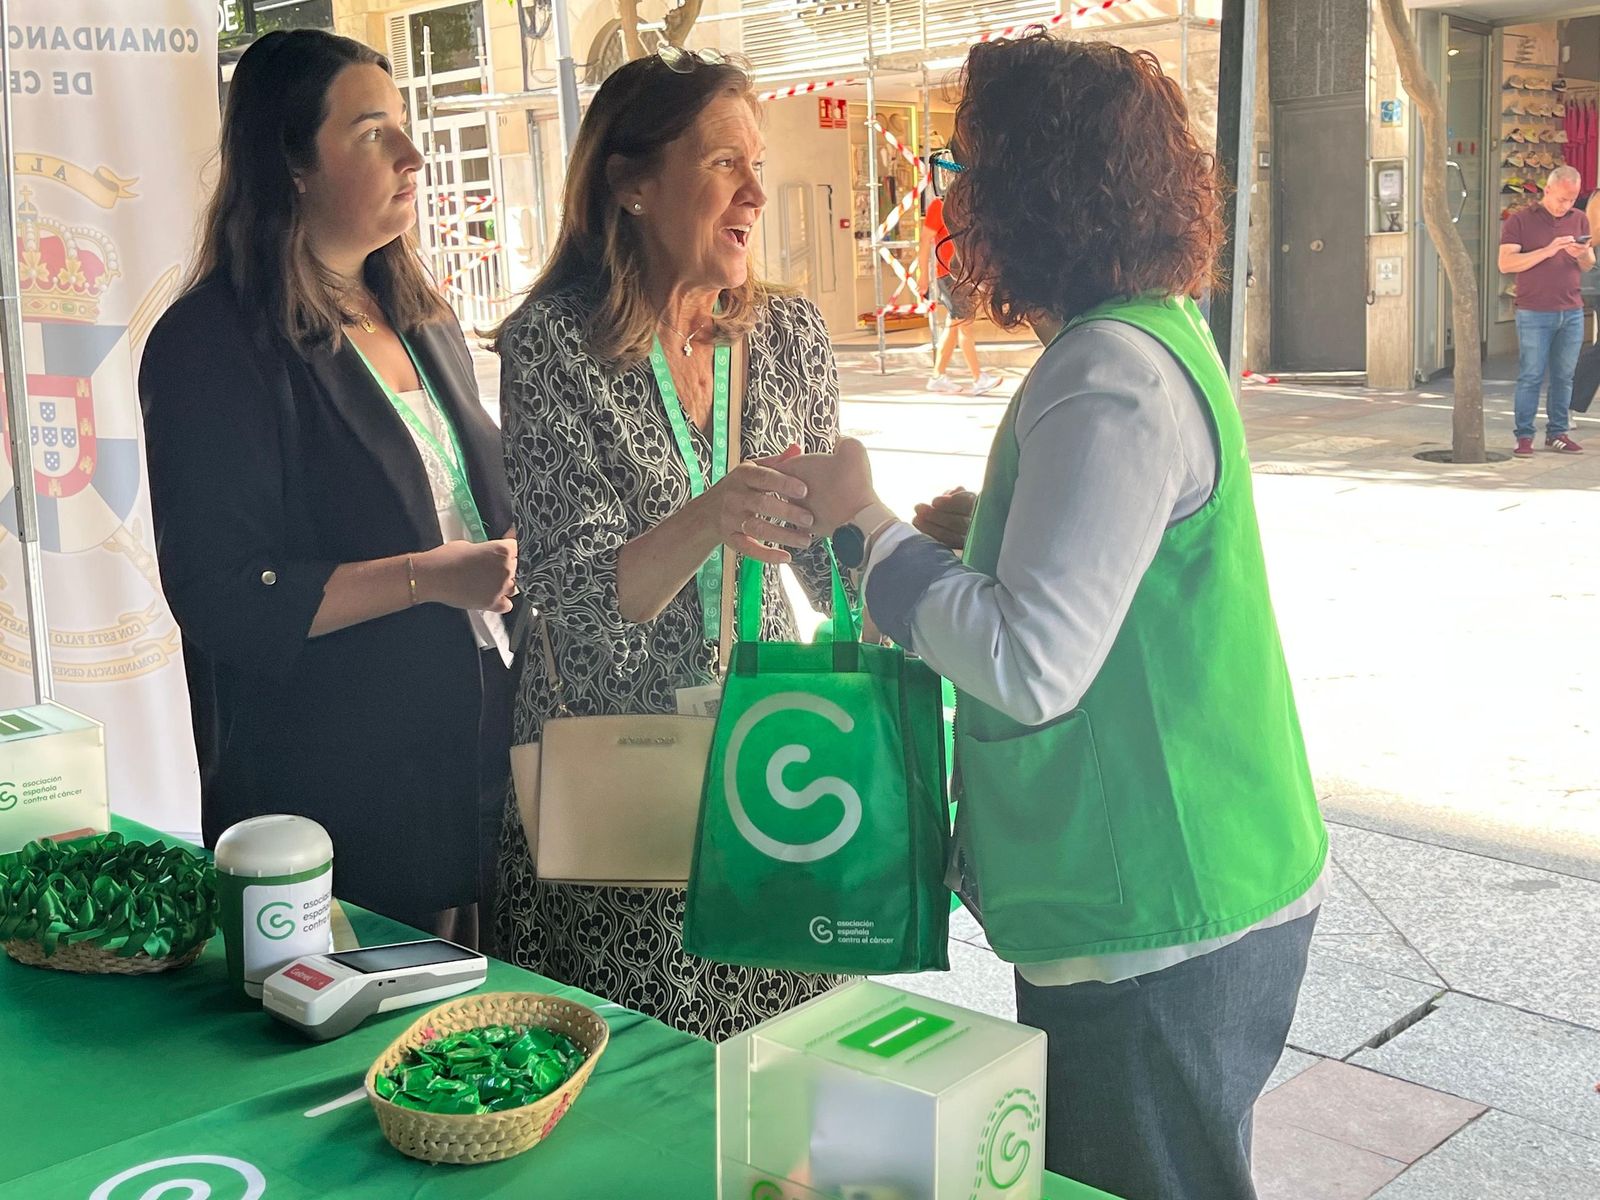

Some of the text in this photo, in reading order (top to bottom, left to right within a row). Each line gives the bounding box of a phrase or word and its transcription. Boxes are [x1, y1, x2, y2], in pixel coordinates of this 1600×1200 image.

[22, 775, 62, 788] asociación
[22, 785, 57, 797] española
[23, 794, 48, 805] contra
[49, 792, 57, 800] el
[837, 919, 875, 928] asociación
[837, 928, 870, 937] española
[861, 936, 868, 944] el
[869, 936, 894, 944] cáncer
